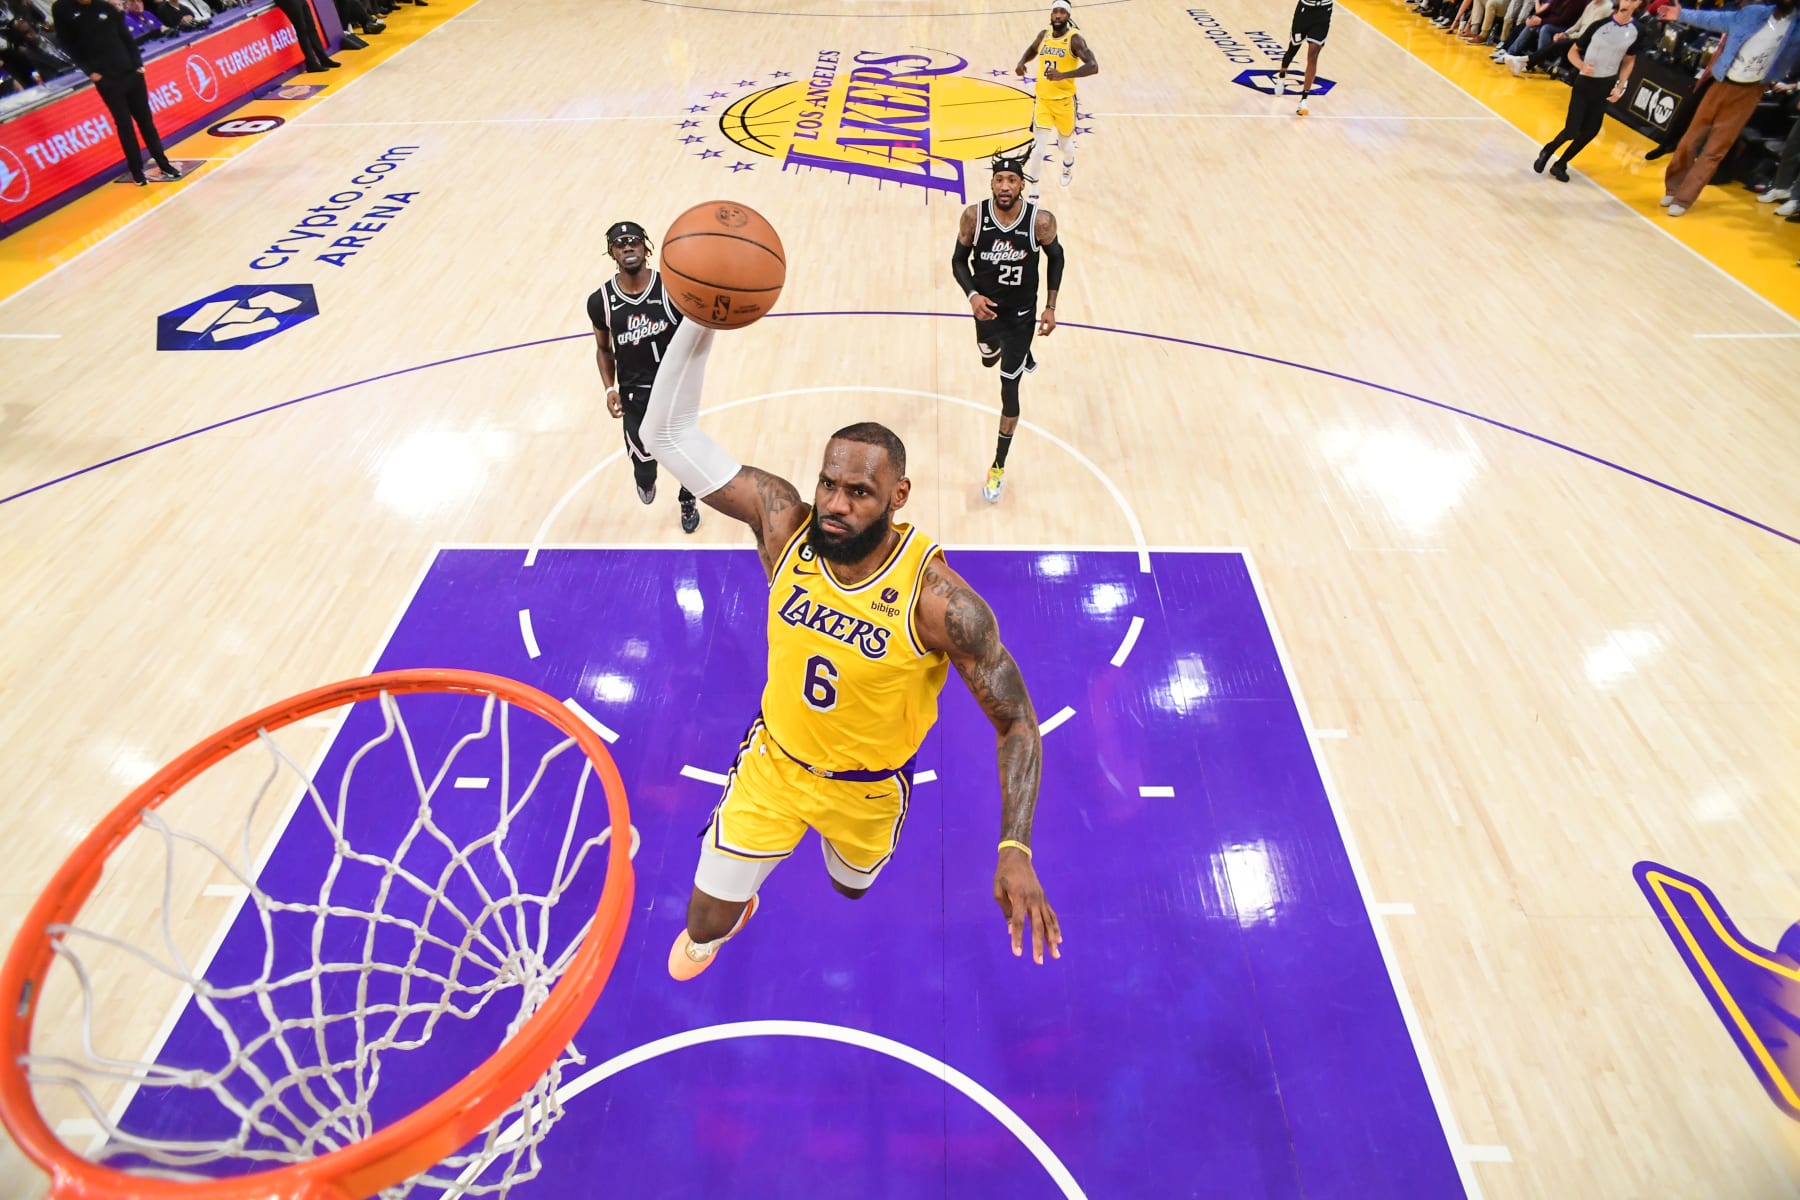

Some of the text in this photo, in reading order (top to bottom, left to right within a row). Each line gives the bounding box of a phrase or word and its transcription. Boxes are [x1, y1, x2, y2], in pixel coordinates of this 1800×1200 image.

[215, 23, 299, 78] TURKISH AIRL
[1186, 9, 1254, 63] crypto.com
[793, 50, 840, 140] LOS ANGELES
[25, 114, 113, 169] TURKISH
[782, 46, 968, 205] LAKERS
[249, 146, 420, 270] crypto.com
[314, 191, 421, 267] ARENA
[980, 248, 1028, 265] angeles
[991, 239, 1013, 252] los
[998, 264, 1023, 286] 23
[617, 319, 669, 346] angeles
[627, 313, 649, 331] los
[801, 545, 813, 560] 6
[778, 584, 891, 659] LAKERS
[870, 601, 900, 617] bibigo
[802, 654, 838, 713] 6
